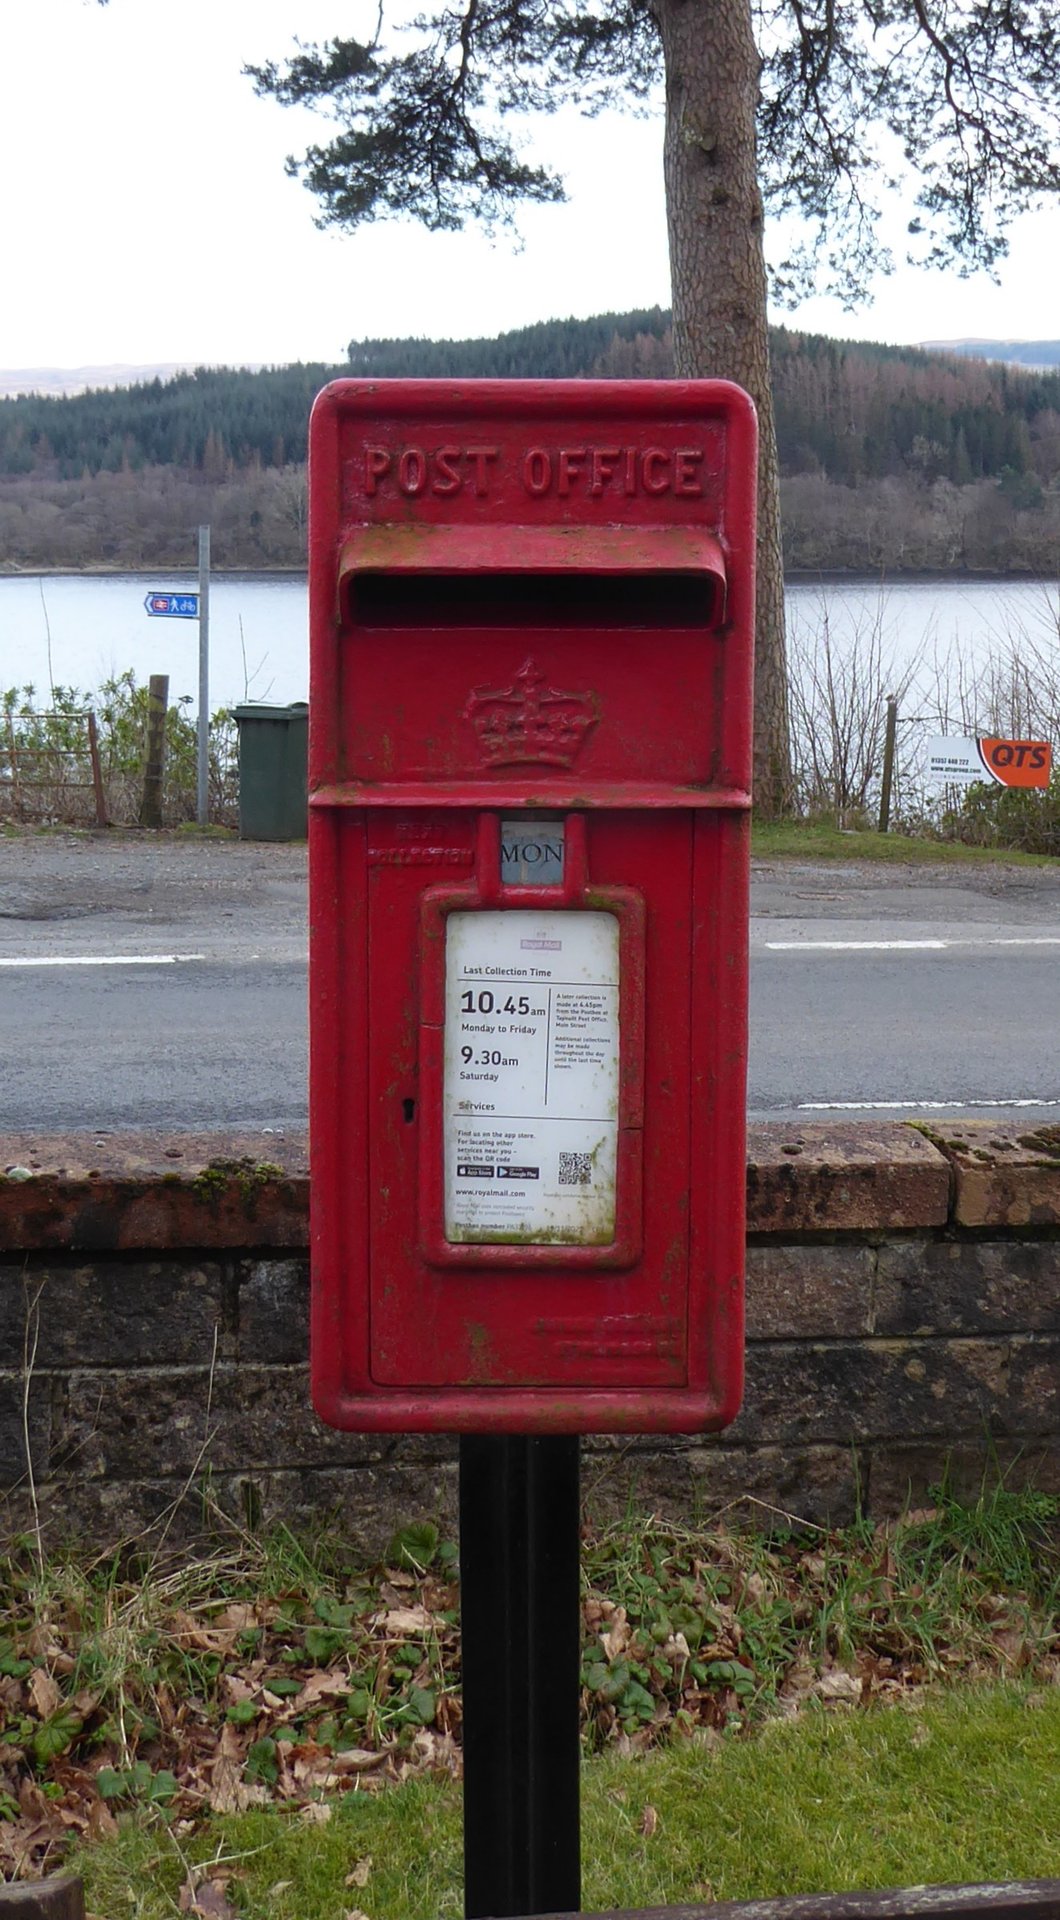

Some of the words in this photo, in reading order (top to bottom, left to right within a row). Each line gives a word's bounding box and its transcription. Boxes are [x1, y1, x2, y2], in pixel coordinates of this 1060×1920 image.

[364, 445, 498, 497] POST
[522, 446, 704, 497] OFFICE
[991, 744, 1047, 769] QTS
[501, 842, 563, 863] MON
[463, 965, 482, 975] Last
[485, 966, 528, 976] Collection
[530, 968, 552, 977] Time
[461, 990, 546, 1016] 10.45am
[461, 1023, 495, 1034] Monday
[498, 1025, 507, 1033] to
[509, 1025, 537, 1036] Friday
[461, 1045, 519, 1067] 9.30am
[460, 1071, 499, 1083] Saturday
[458, 1102, 495, 1111] Services
[469, 1139, 495, 1147] locating
[455, 1189, 526, 1197] www.royalmail.com
